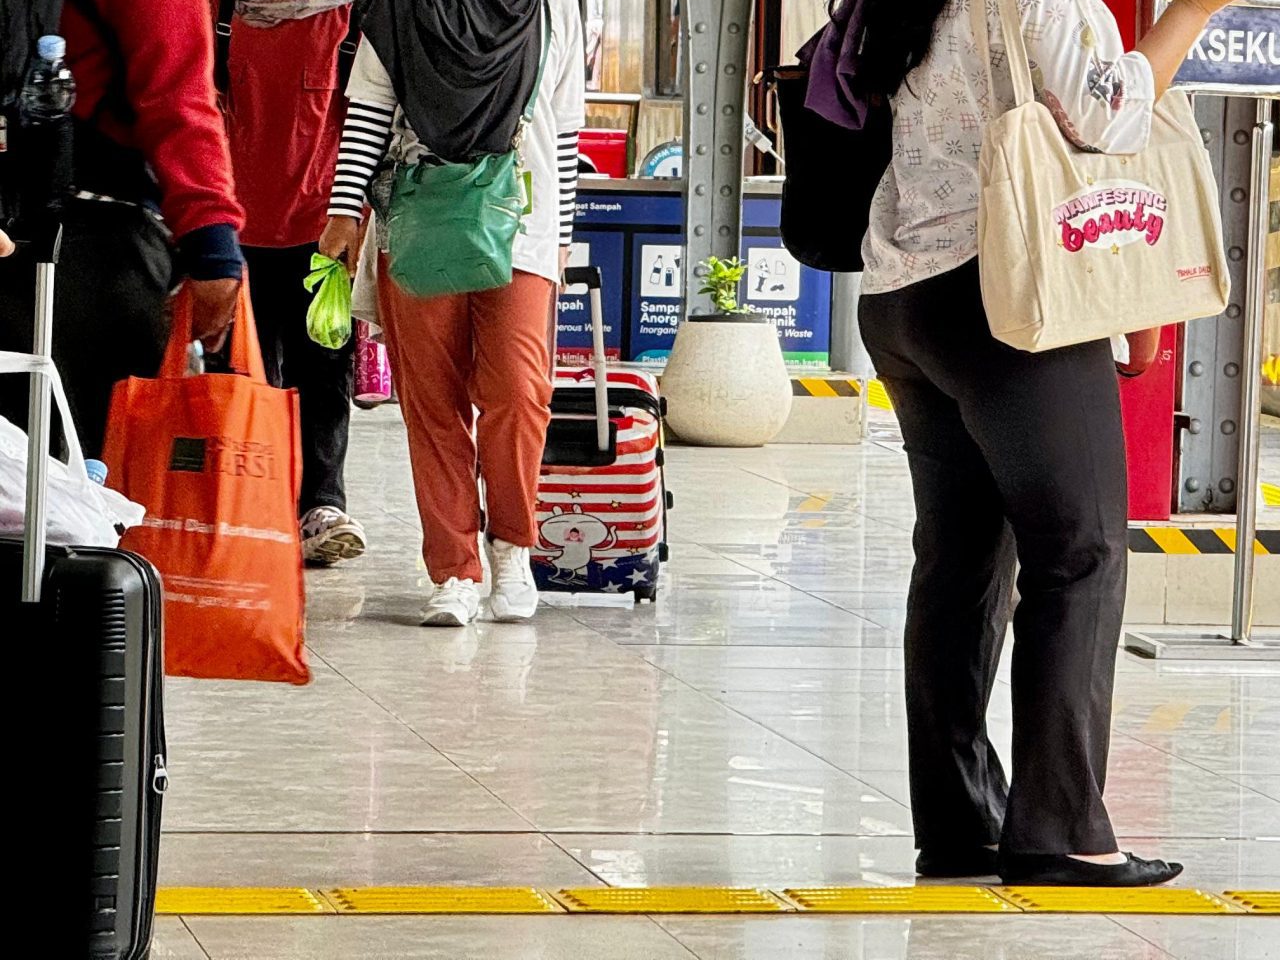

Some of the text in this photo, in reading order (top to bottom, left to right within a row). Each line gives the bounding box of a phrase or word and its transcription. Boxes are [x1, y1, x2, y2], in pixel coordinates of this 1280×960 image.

[590, 202, 622, 212] Sampah
[1062, 202, 1164, 252] beauty
[557, 324, 582, 332] erous
[785, 328, 813, 338] Waste
